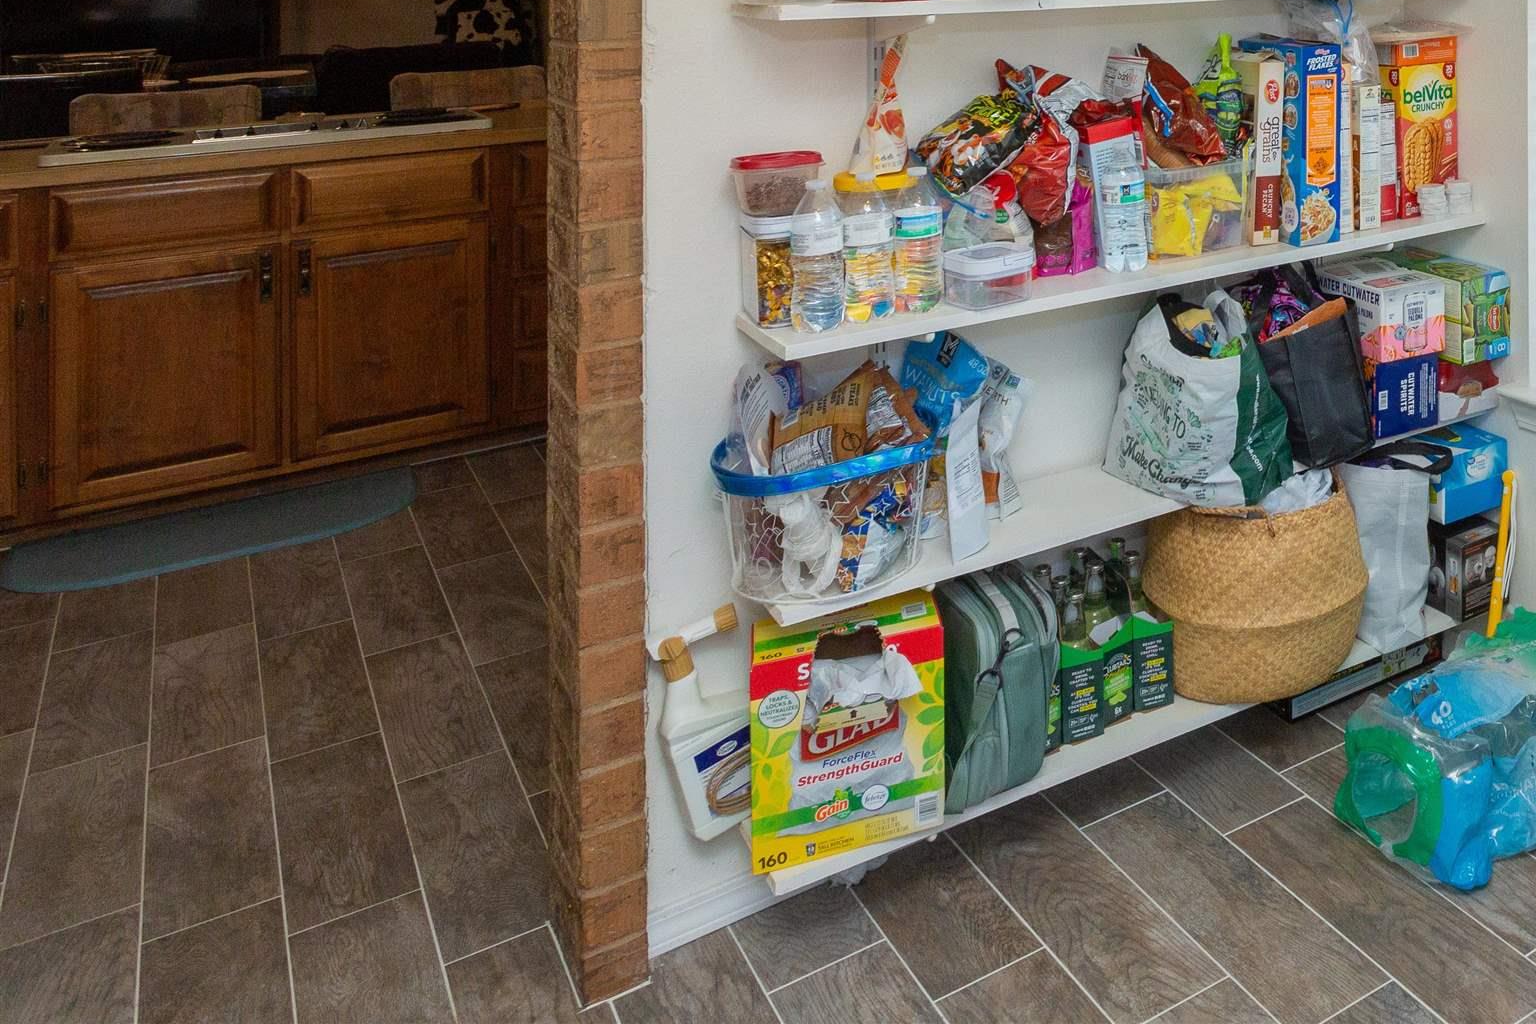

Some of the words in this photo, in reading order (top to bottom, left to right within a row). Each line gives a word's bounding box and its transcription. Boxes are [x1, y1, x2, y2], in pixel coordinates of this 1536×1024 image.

[1306, 54, 1336, 65] FROSTED
[1309, 61, 1334, 71] FLAKES
[1268, 81, 1279, 102] Post
[1403, 79, 1453, 104] belVita
[1411, 101, 1445, 113] CRUNCHY
[1259, 118, 1272, 164] grains
[1343, 282, 1380, 306] CUTWATER
[1407, 307, 1424, 315] TEQUILA
[1408, 313, 1423, 322] PALOMA
[848, 384, 856, 406] STEAKS
[1172, 412, 1186, 438] TO
[1125, 435, 1150, 470] Make
[760, 652, 782, 660] 160
[760, 704, 798, 716] NEUTRALIZES
[766, 702, 786, 710] LOCKS
[1432, 700, 1452, 726] 40
[822, 750, 876, 768] ForceFlex
[797, 752, 903, 787] StrengthGuard
[816, 799, 848, 822] Gain
[758, 852, 788, 869] 160
